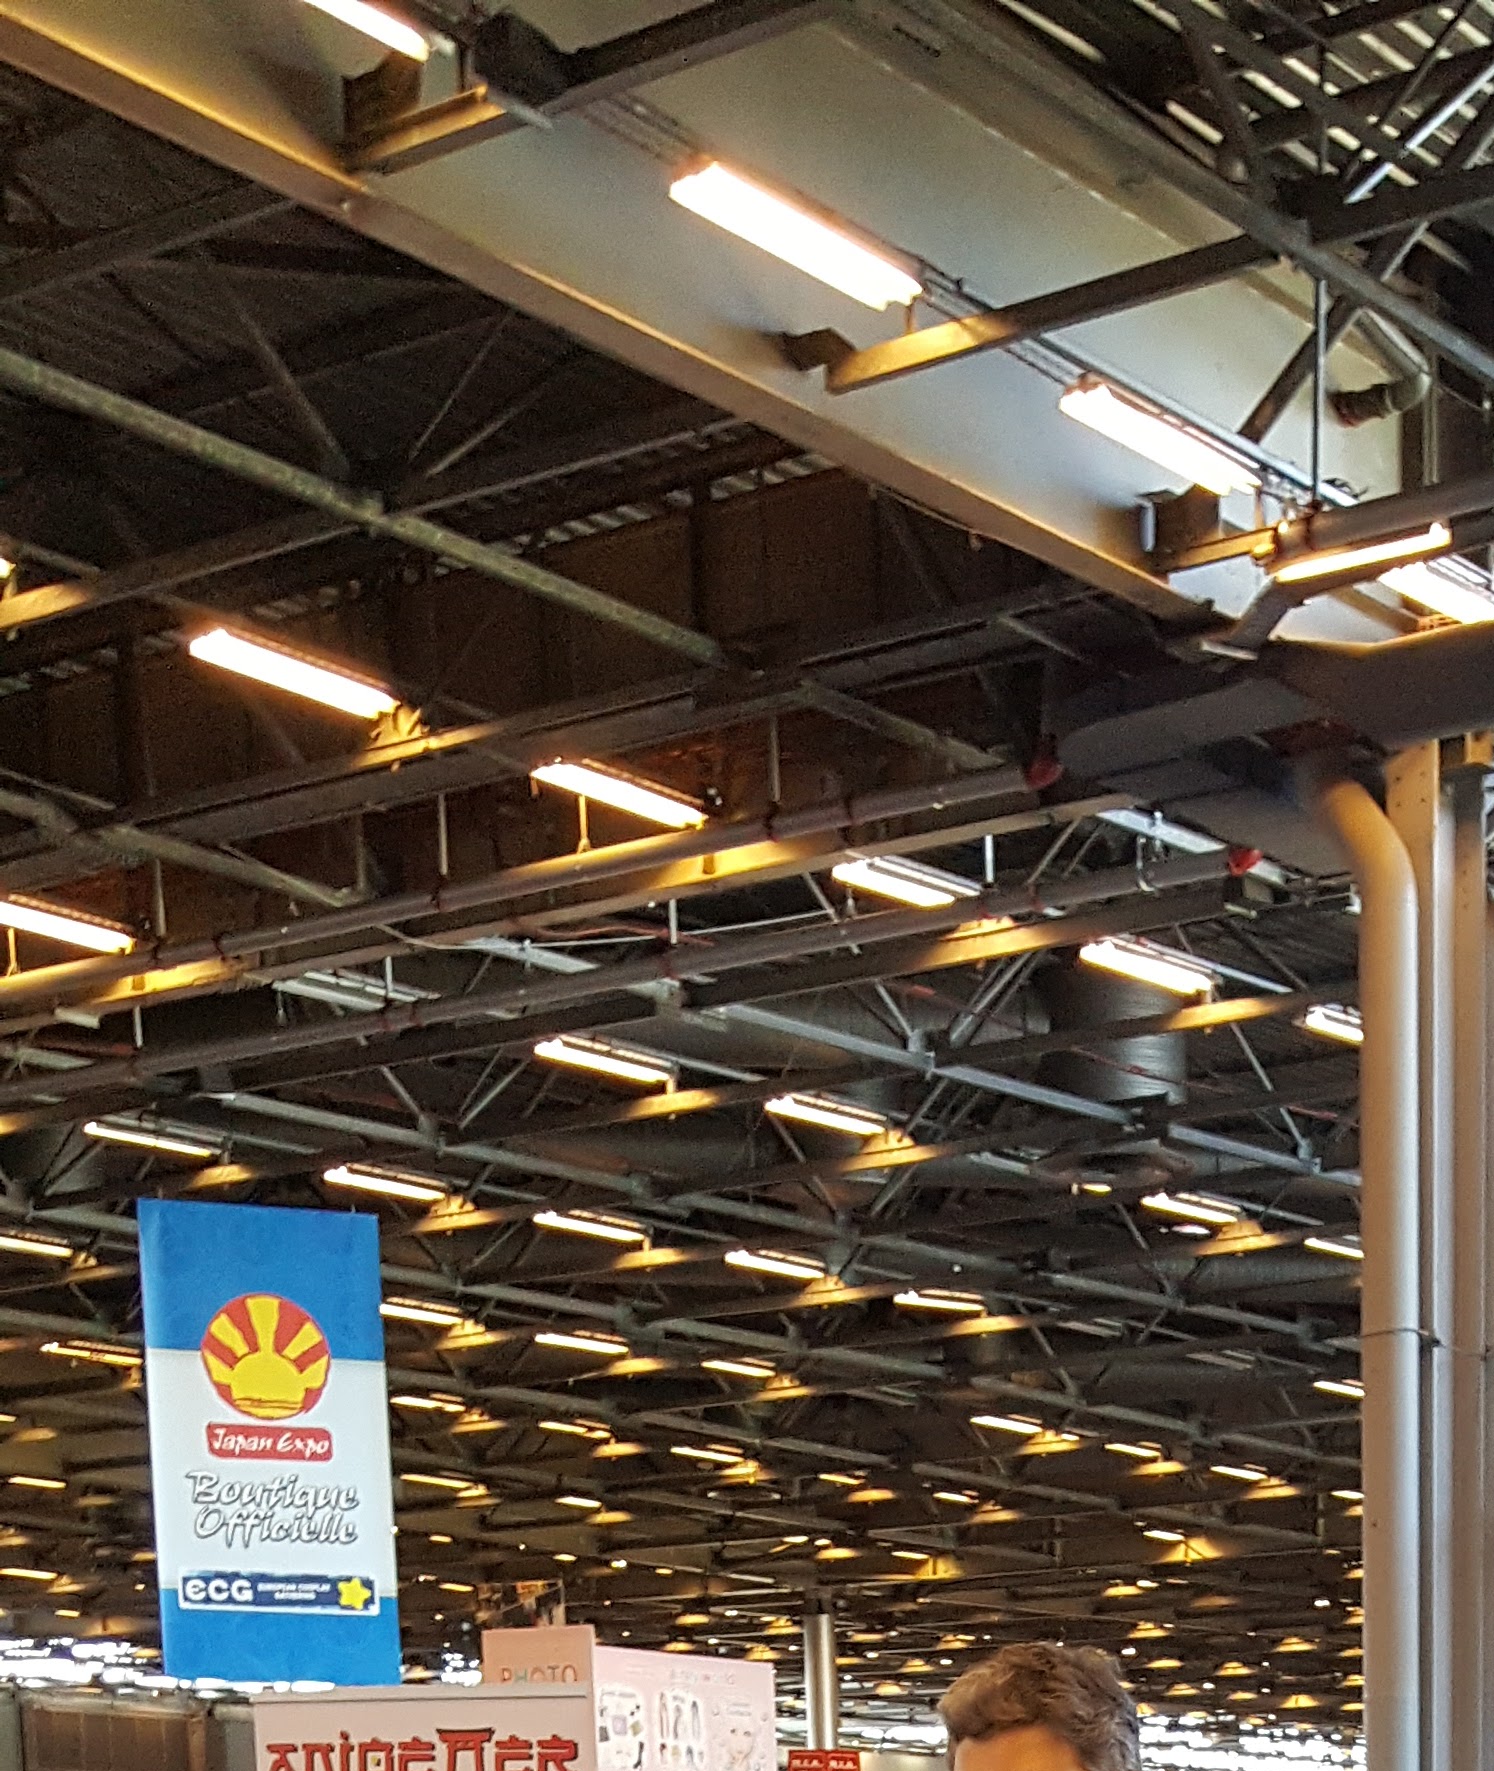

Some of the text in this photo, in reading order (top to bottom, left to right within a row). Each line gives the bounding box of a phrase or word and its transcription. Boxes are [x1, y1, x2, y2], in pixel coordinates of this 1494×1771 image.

[213, 1427, 330, 1458] Japan Expo
[186, 1470, 360, 1519] Boutique
[193, 1504, 359, 1549] Officielle
